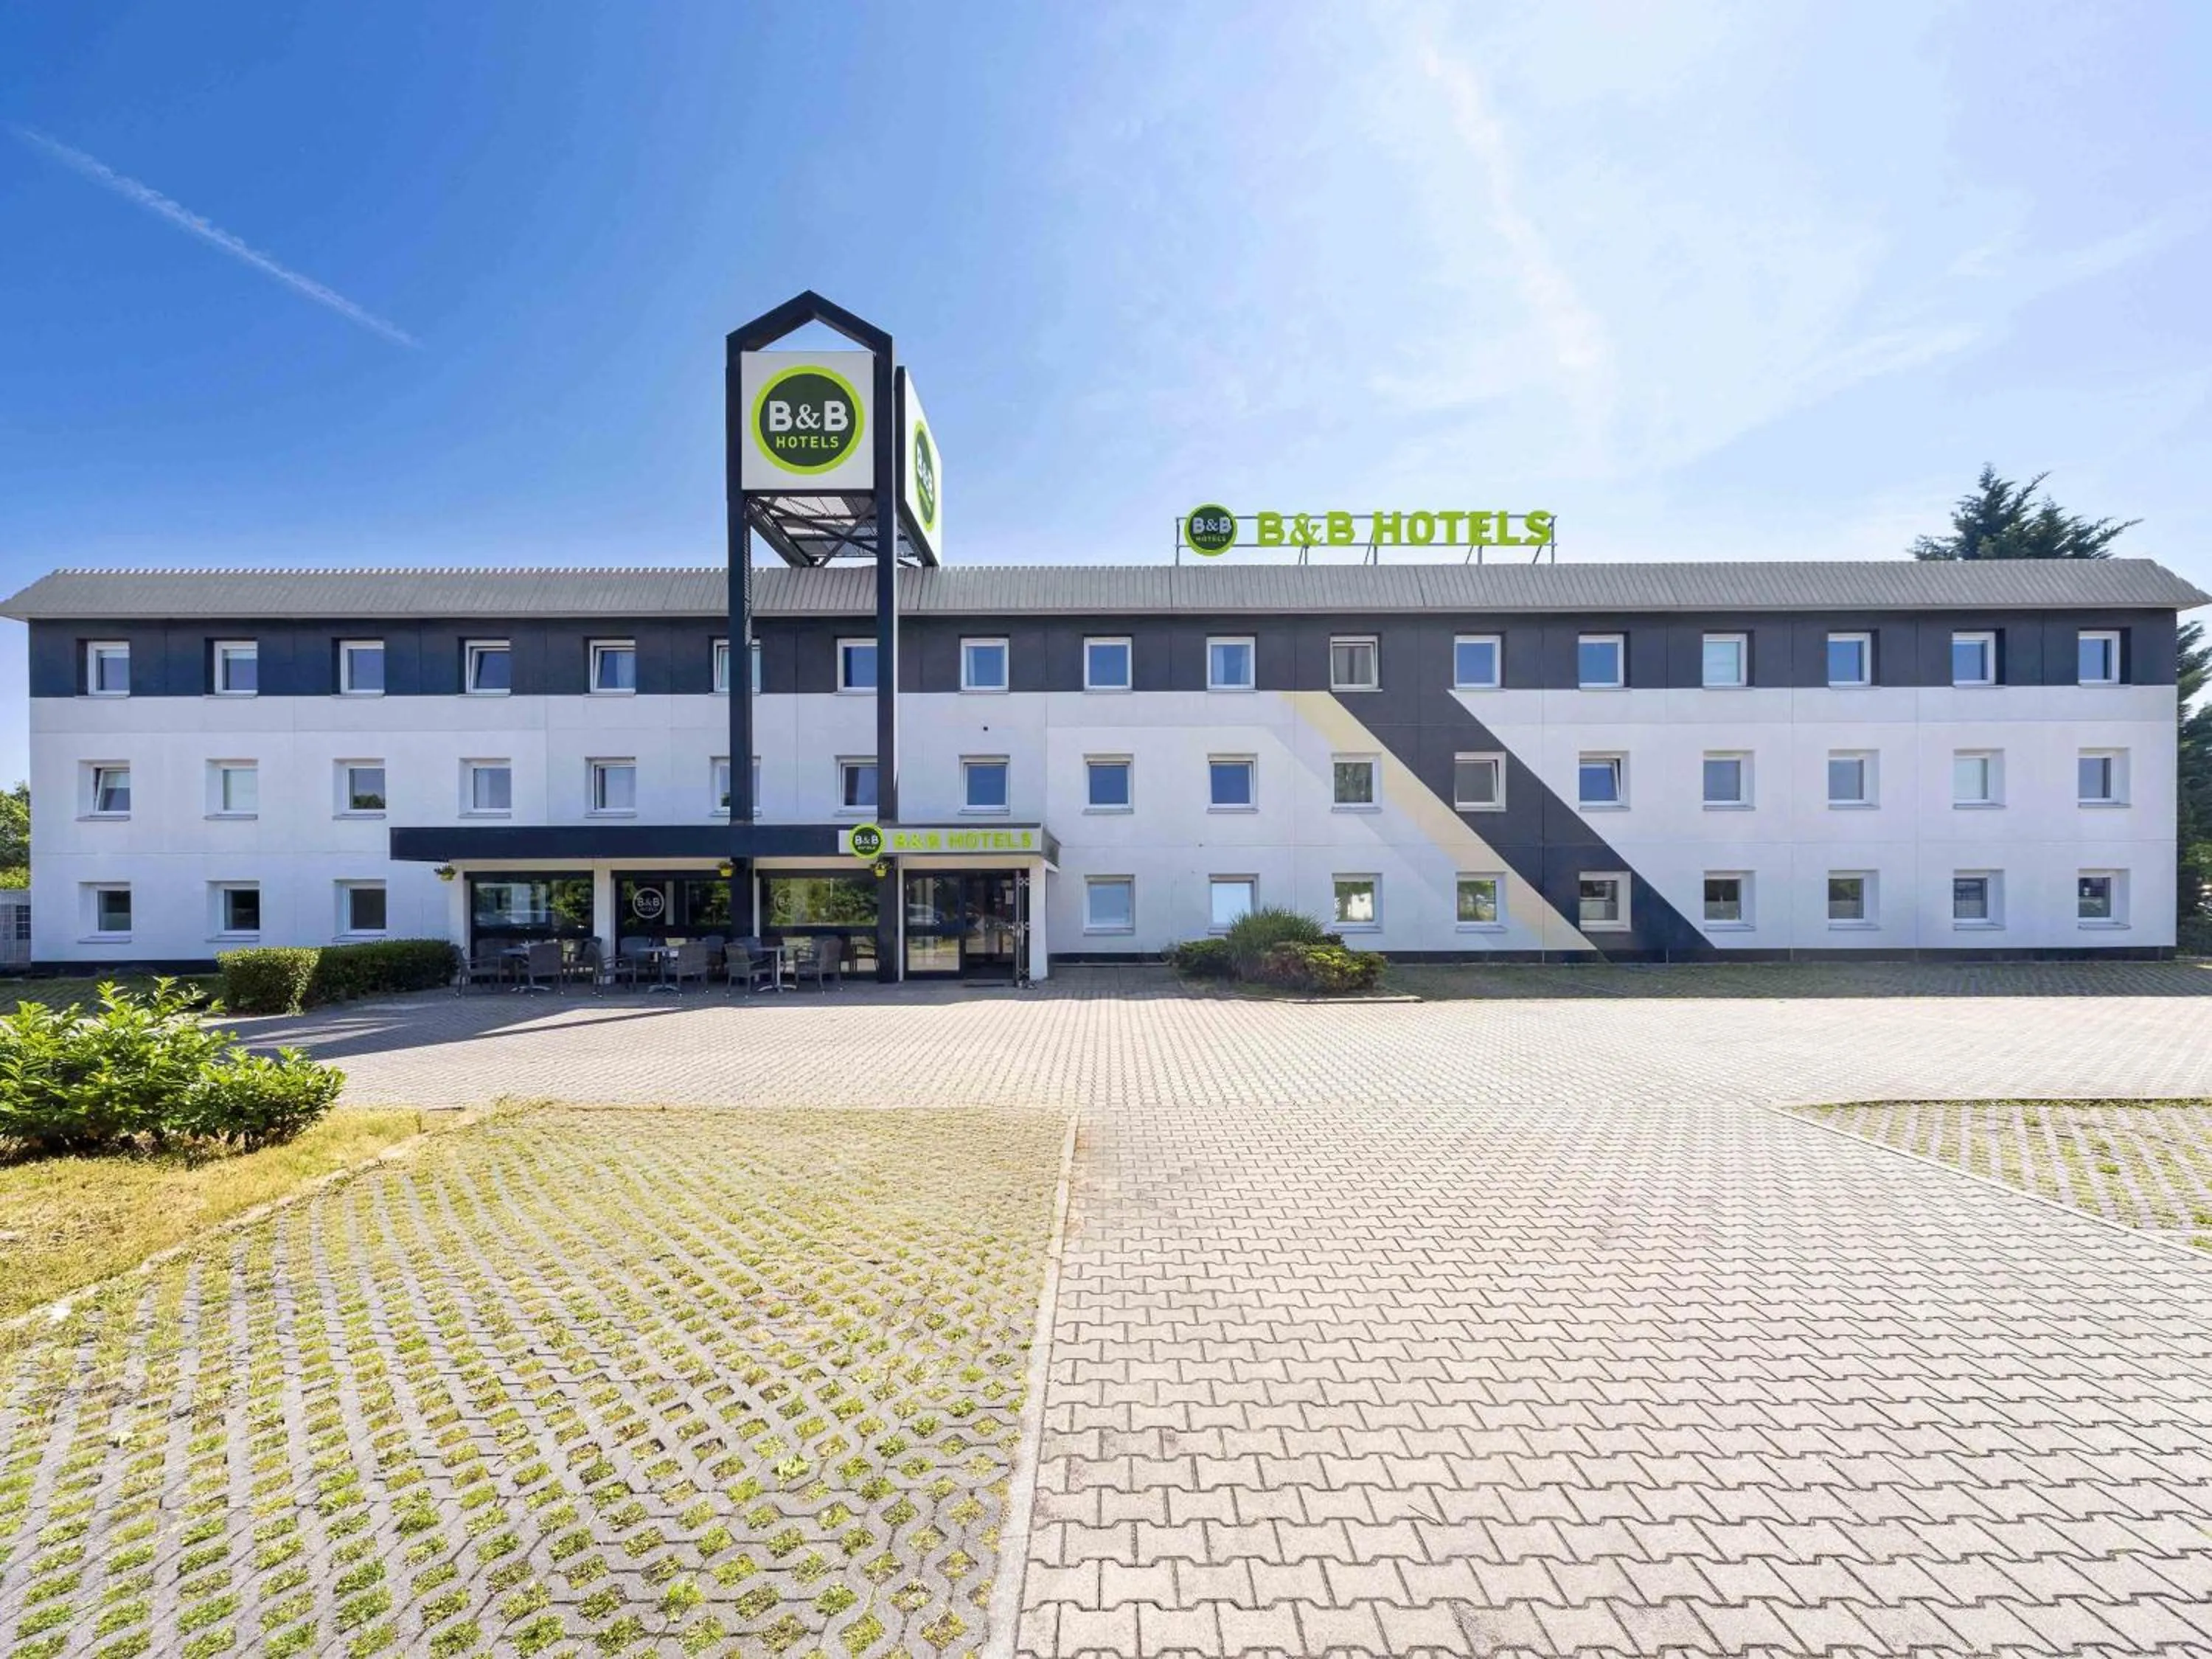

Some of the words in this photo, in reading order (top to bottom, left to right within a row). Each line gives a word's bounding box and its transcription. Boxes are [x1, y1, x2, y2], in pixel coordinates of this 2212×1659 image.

[768, 400, 849, 431] B&B
[776, 436, 839, 449] HOTELS
[1192, 517, 1231, 534] B&B
[1257, 511, 1355, 547] B&B
[1372, 510, 1552, 546] HOTELS
[855, 835, 879, 845] B&B
[893, 832, 942, 850] B&B
[947, 831, 1032, 849] HOTELS
